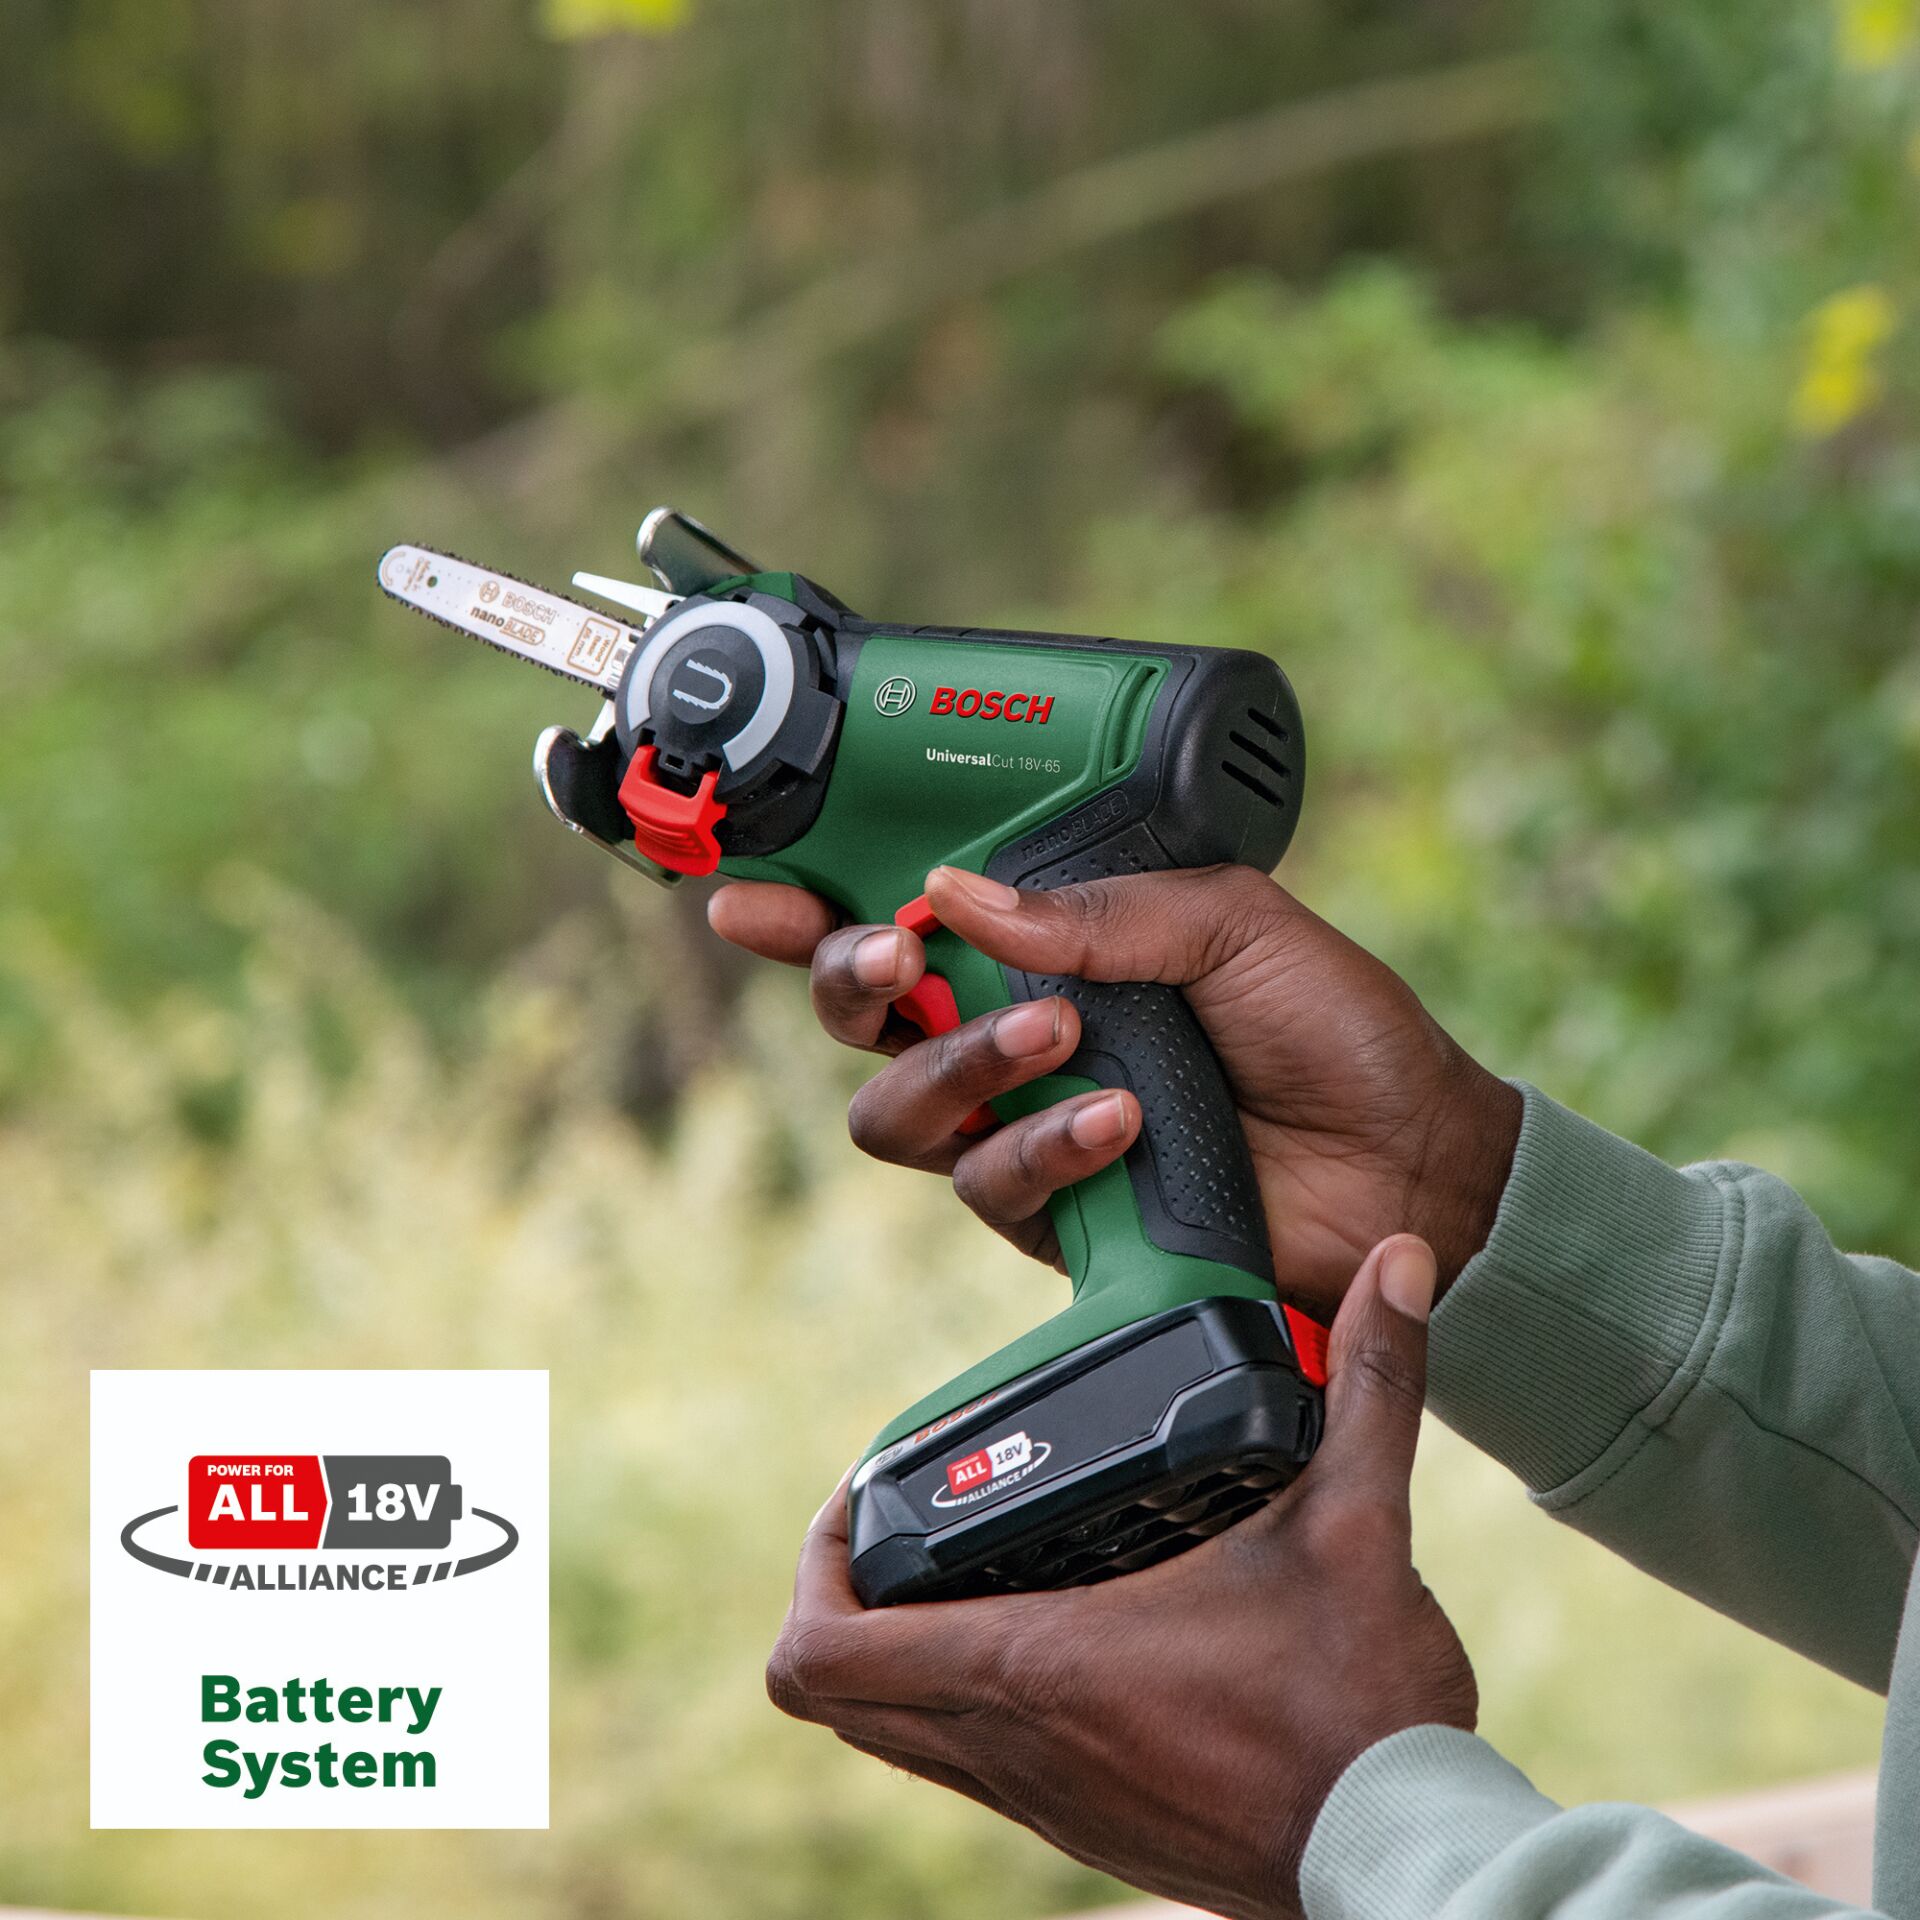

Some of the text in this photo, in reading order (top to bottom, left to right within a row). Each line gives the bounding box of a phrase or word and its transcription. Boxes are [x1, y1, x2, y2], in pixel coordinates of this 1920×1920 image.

[501, 591, 557, 625] BOSCH
[929, 686, 1055, 724] BOSCH
[926, 747, 1061, 774] UniversalCut 18V-65
[955, 1462, 987, 1485] ALL
[996, 1442, 1022, 1465] 18V
[967, 1471, 1021, 1504] ALLIANCE
